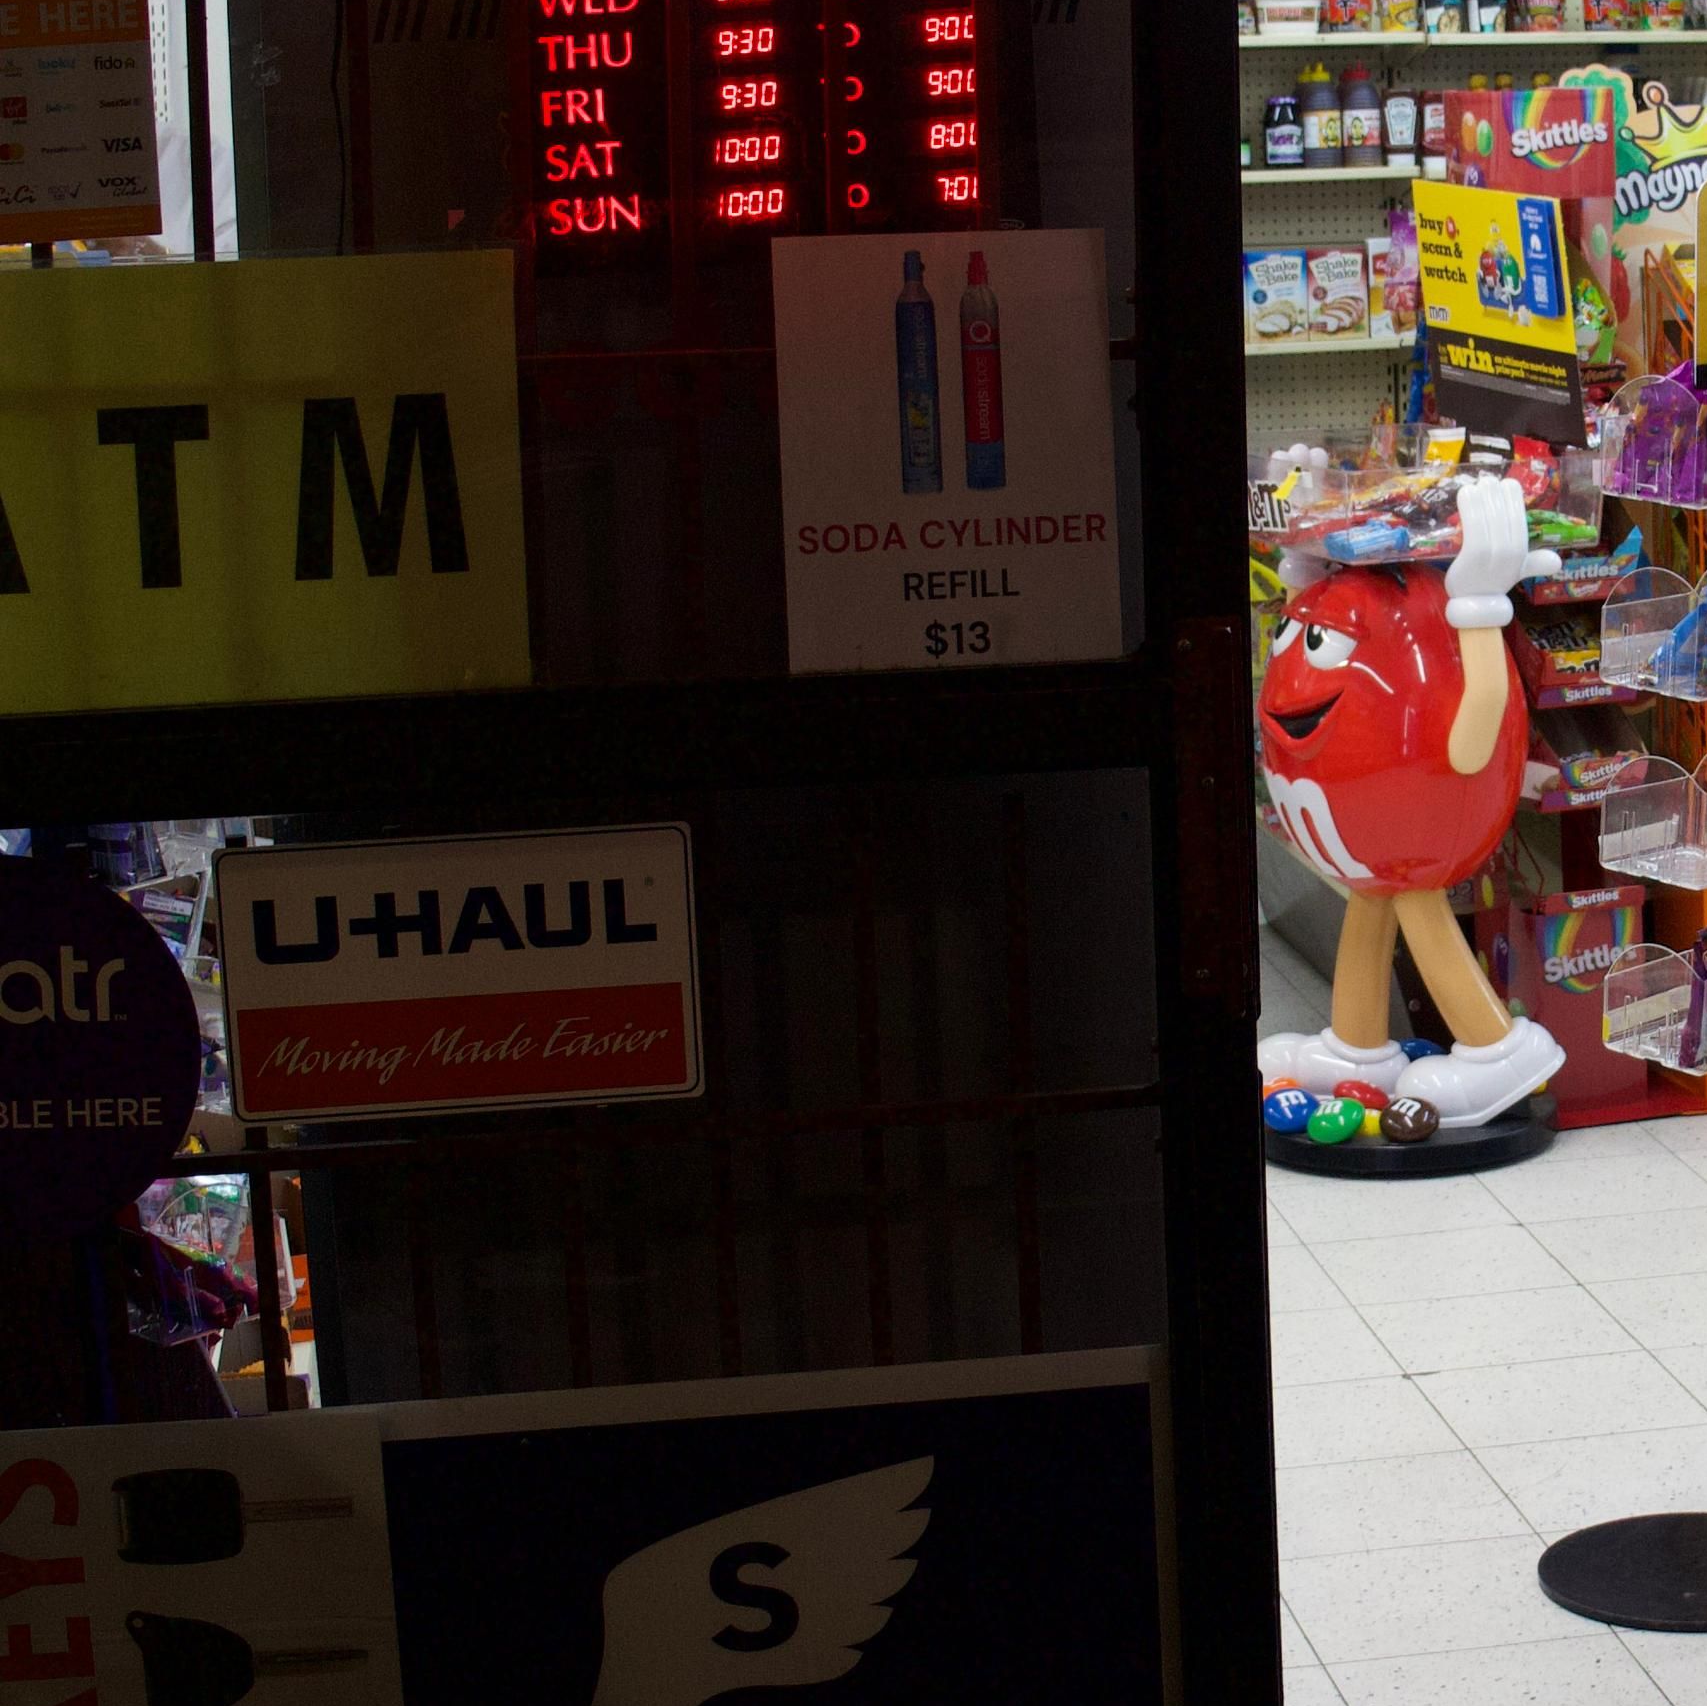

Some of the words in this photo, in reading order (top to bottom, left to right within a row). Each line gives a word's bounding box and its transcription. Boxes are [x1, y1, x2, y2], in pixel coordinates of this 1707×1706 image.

[539, 32, 634, 71] THU
[719, 28, 774, 56] 9:30
[94, 56, 122, 70] fido
[541, 90, 606, 126] FRI
[722, 82, 778, 110] 9:30
[102, 137, 142, 153] VISA
[1512, 120, 1608, 158] Skittles
[546, 142, 622, 181] SAT
[715, 136, 781, 164] 10:00
[98, 177, 137, 188] VOX
[549, 195, 641, 236] SUN
[719, 188, 784, 217] 10:00
[1419, 213, 1444, 235] buy
[1422, 242, 1453, 258] scan
[1454, 247, 1464, 259] &
[1254, 261, 1299, 276] Shake
[1315, 257, 1359, 275] Shake
[1327, 268, 1360, 282] Bake
[1425, 263, 1468, 284] watch
[1266, 272, 1299, 287] Bake
[1447, 338, 1495, 374] win
[798, 521, 907, 554] SODA
[919, 514, 1107, 549] CYLINDER
[1553, 563, 1619, 582] Skittles
[903, 569, 1021, 601] REFILL
[926, 619, 991, 659] $13
[1565, 685, 1613, 703] Skittles
[1579, 760, 1629, 783] Skittles
[1570, 785, 1621, 806] Skittles
[1572, 890, 1620, 909] Skittles
[252, 879, 657, 965] U-HAUL
[1544, 943, 1638, 983] Skittles
[256, 1036, 409, 1085] Moving
[411, 1022, 538, 1069] Made
[533, 1014, 669, 1062] Easier
[66, 1095, 164, 1129] HERE
